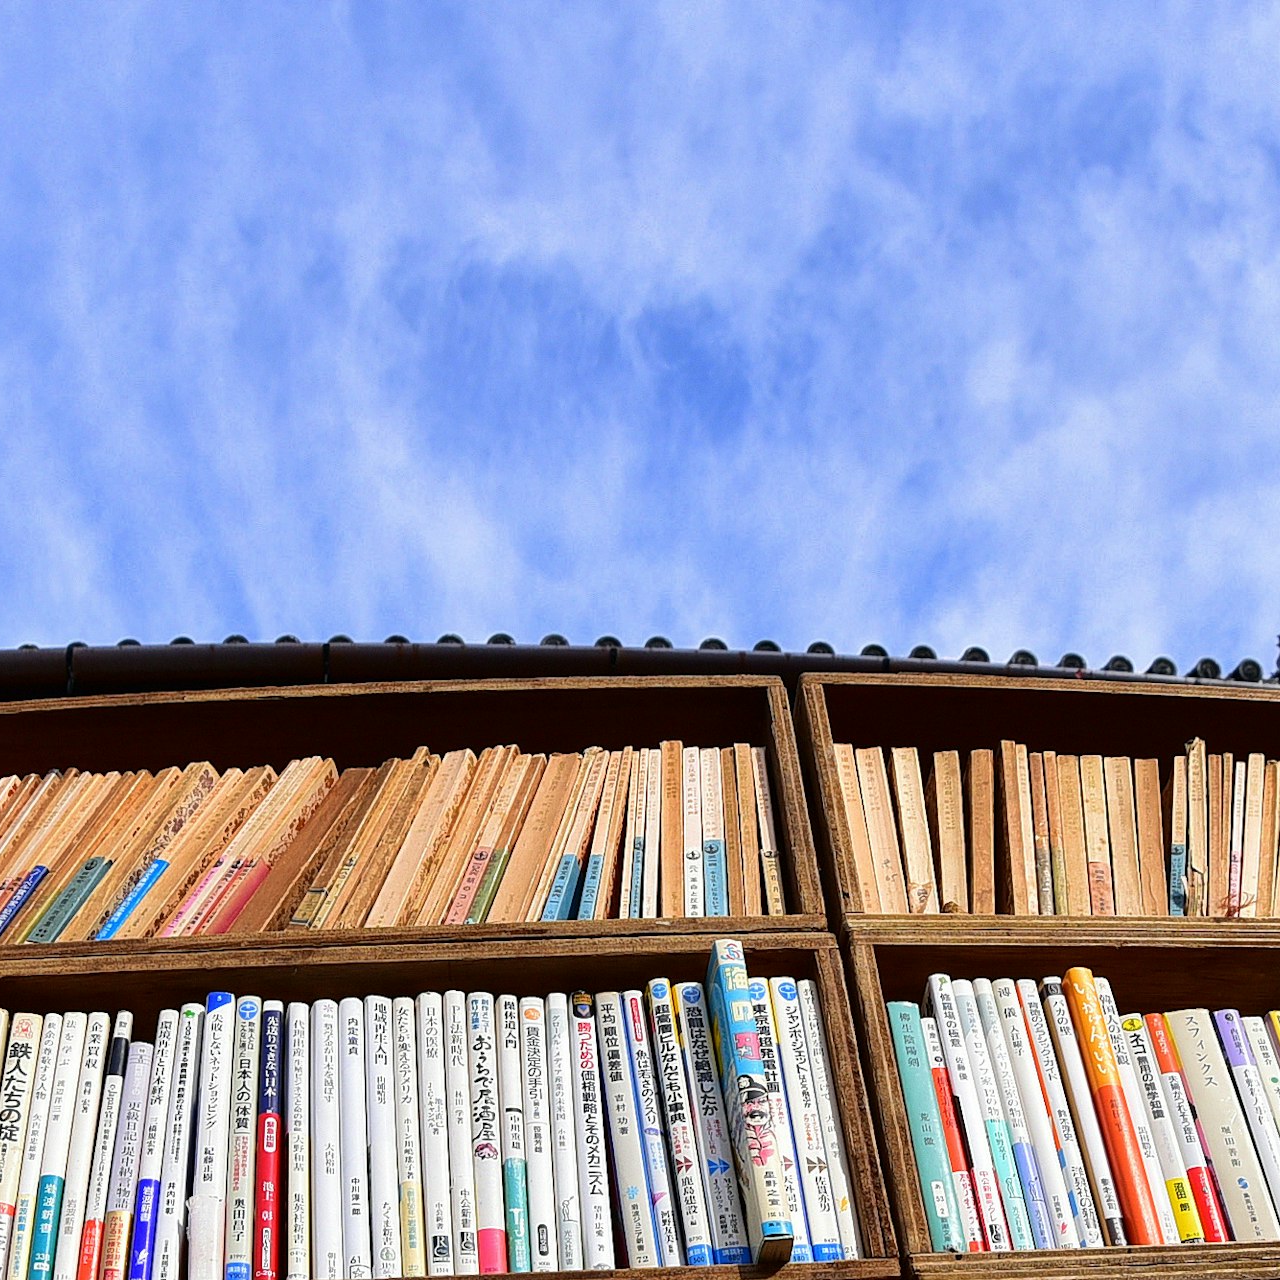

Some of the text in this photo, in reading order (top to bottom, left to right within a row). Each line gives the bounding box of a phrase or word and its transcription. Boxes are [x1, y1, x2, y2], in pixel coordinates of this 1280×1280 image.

[84, 1021, 103, 1070] 企業買収
[348, 1017, 359, 1055] 内定童貞
[374, 1002, 388, 1065] 地域再生入門
[426, 1006, 439, 1058] 日本の医療
[600, 1004, 624, 1082] 平均順位偏差値
[724, 967, 761, 1061] 海の牙
[150, 1021, 172, 1105] 環境再生と日本経済
[204, 1014, 224, 1128] 失敗しないネットショッピング
[264, 1016, 279, 1096] 先送りできない日本
[397, 1006, 413, 1104] 女たちが変えるアメリカ
[472, 1034, 496, 1141] おうちで居酒屋
[526, 1027, 543, 1100] 賃金決定の手引
[636, 1050, 656, 1125] 魚は若さのクスリ
[655, 1005, 686, 1123] 超高層ビルなんでも小事典
[1186, 1017, 1218, 1088] スフィンクス
[234, 1059, 252, 1134] 日本人の「体質」
[578, 1021, 603, 1196] 勝つための価格戦略とそのメカニズム
[231, 1198, 246, 1242] 奥田昌子
